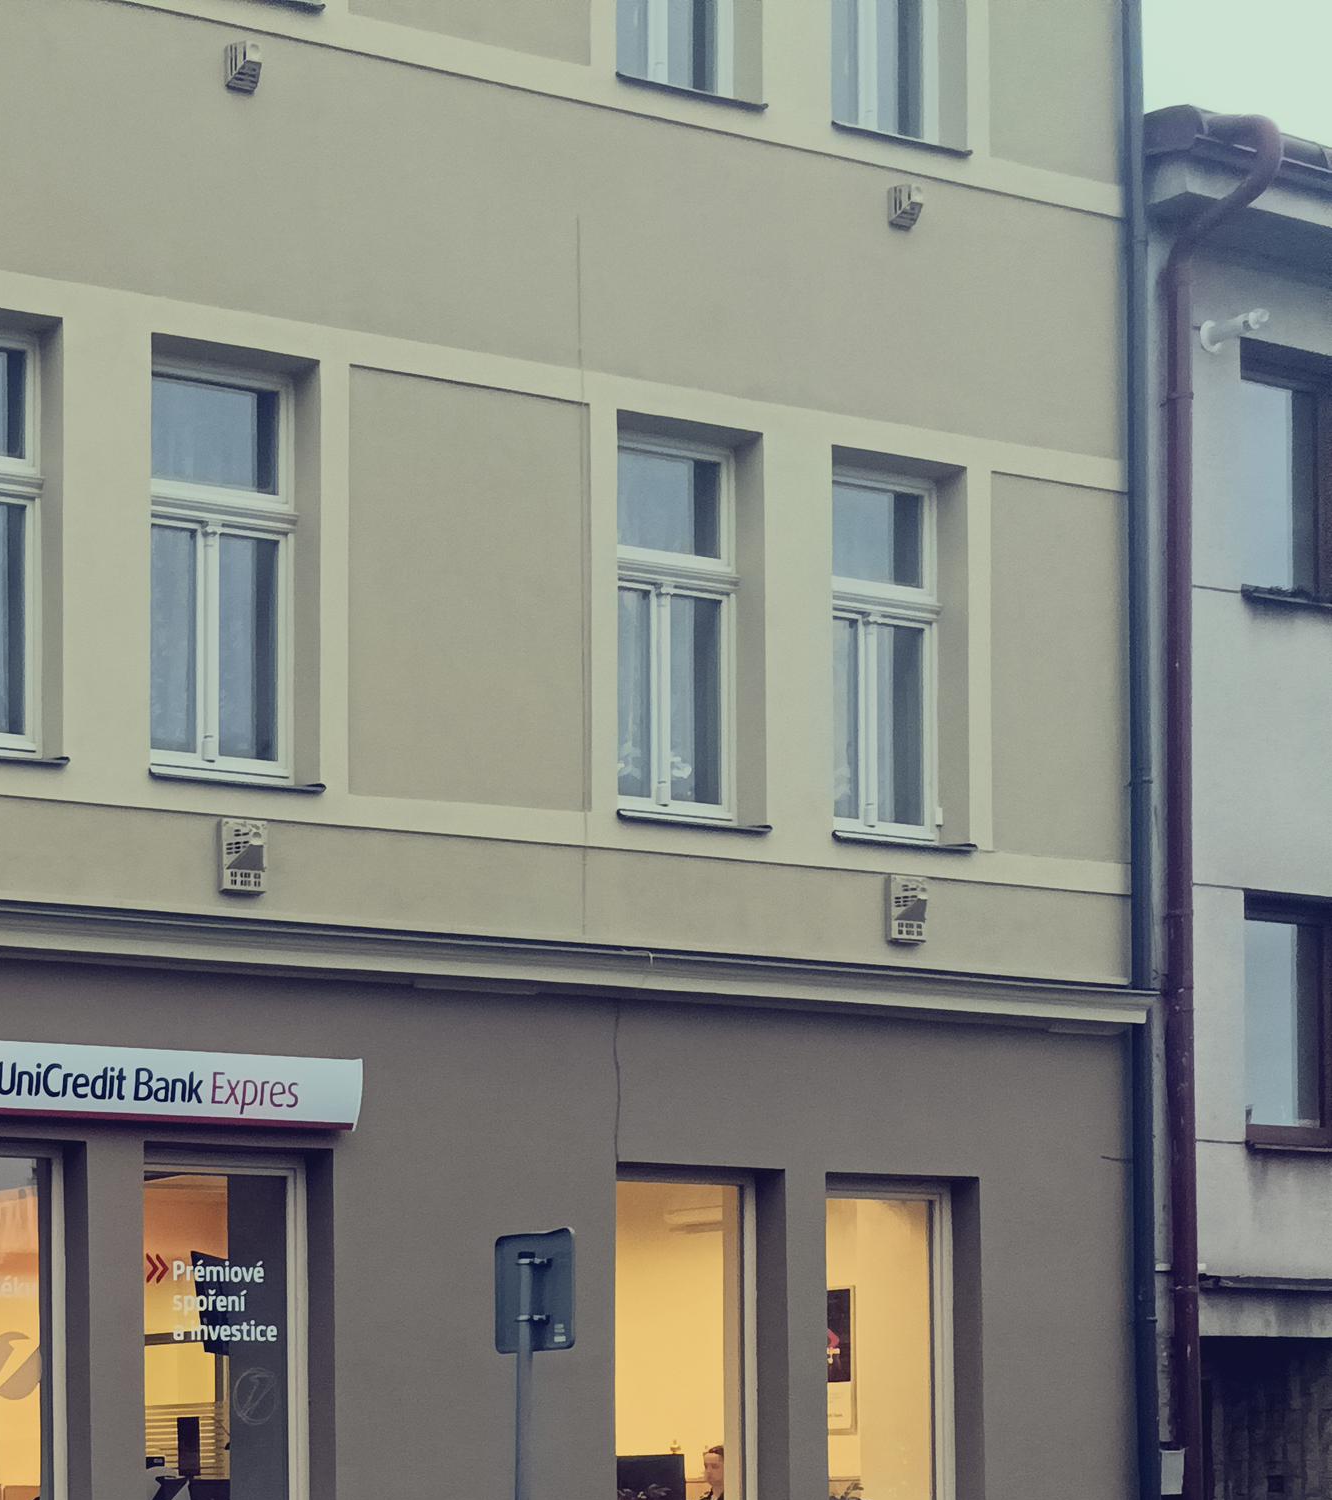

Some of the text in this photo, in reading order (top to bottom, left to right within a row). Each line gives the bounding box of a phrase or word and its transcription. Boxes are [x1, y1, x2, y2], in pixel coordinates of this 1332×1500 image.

[133, 1067, 205, 1104] Bank
[211, 1071, 299, 1115] Expres
[172, 1259, 265, 1283] Prémiové
[172, 1288, 248, 1315] spoření
[172, 1319, 278, 1342] a investice
